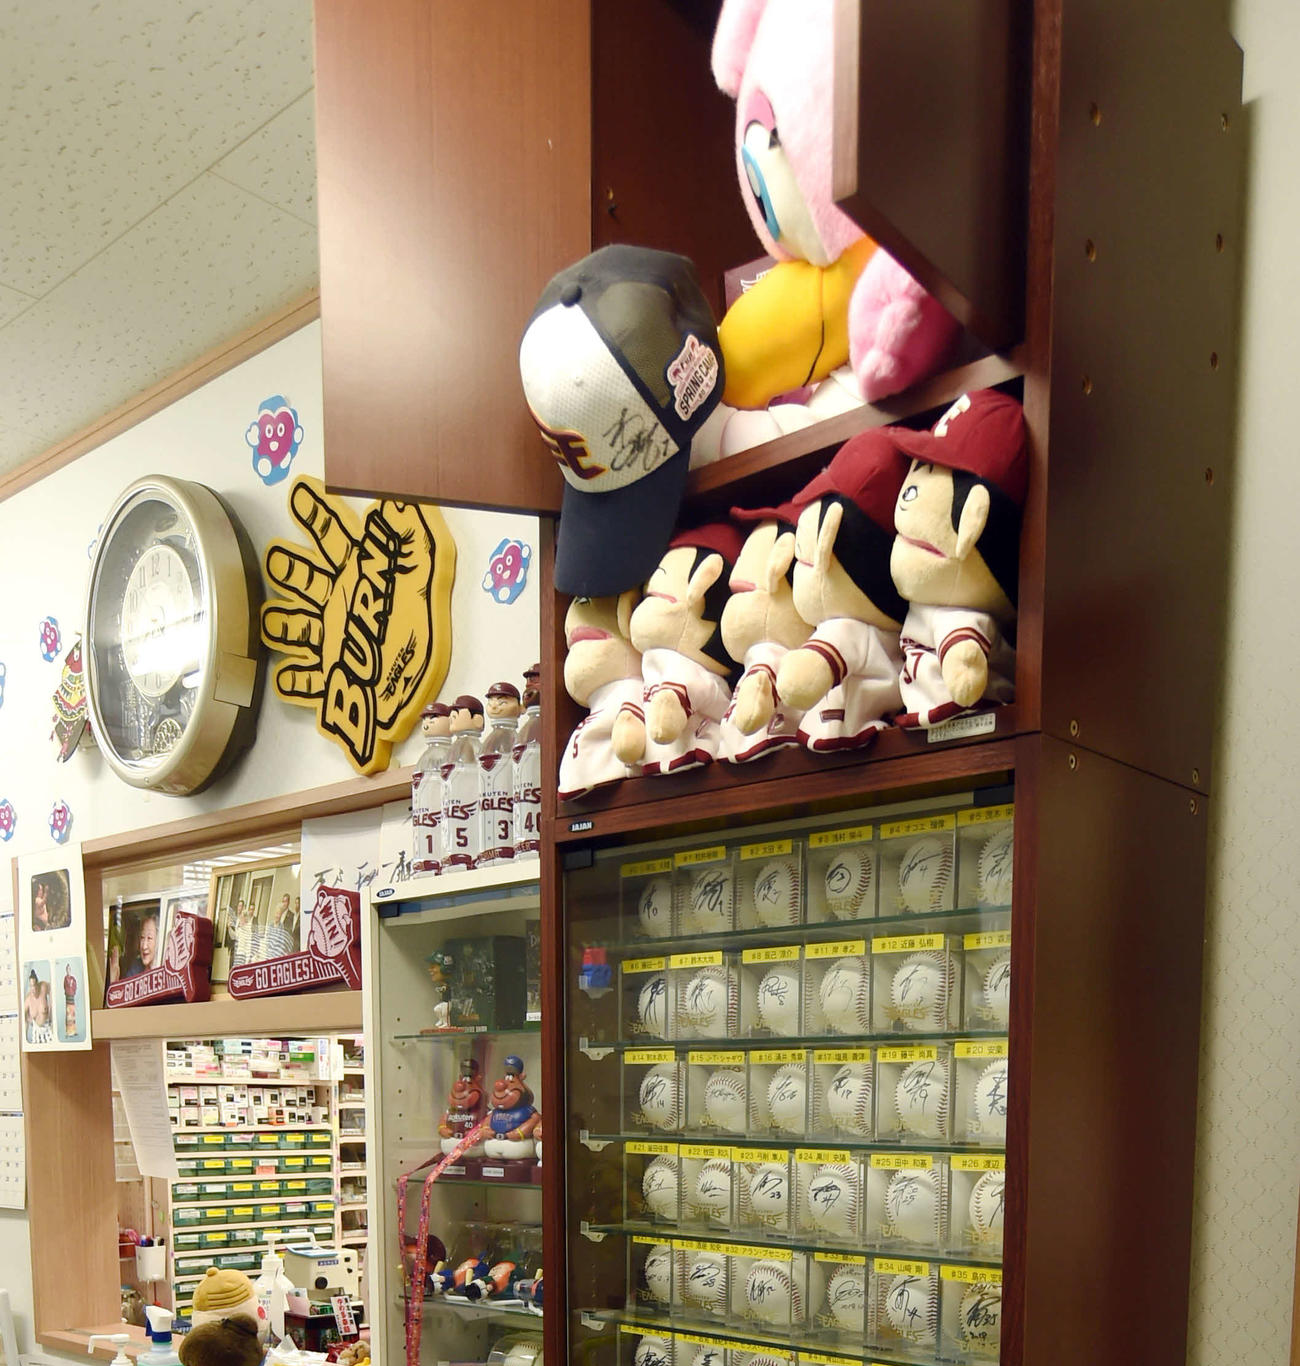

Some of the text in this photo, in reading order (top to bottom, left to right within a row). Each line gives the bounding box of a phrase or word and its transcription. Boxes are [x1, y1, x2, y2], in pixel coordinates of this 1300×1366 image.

[680, 370, 704, 415] SPRING
[387, 647, 416, 698] EAGLES
[456, 828, 468, 848] 5
[498, 820, 514, 840] 3
[425, 834, 433, 853] 1
[320, 899, 345, 950] WIN!
[255, 957, 314, 989] GO EAGLES!
[134, 970, 166, 998] EAGLES!
[875, 1158, 891, 1167] #25
[894, 1158, 909, 1168] 田中
[961, 1158, 979, 1168] #26
[769, 1191, 782, 1200] 23
[878, 1262, 894, 1271] #34
[951, 1270, 968, 1280] #35
